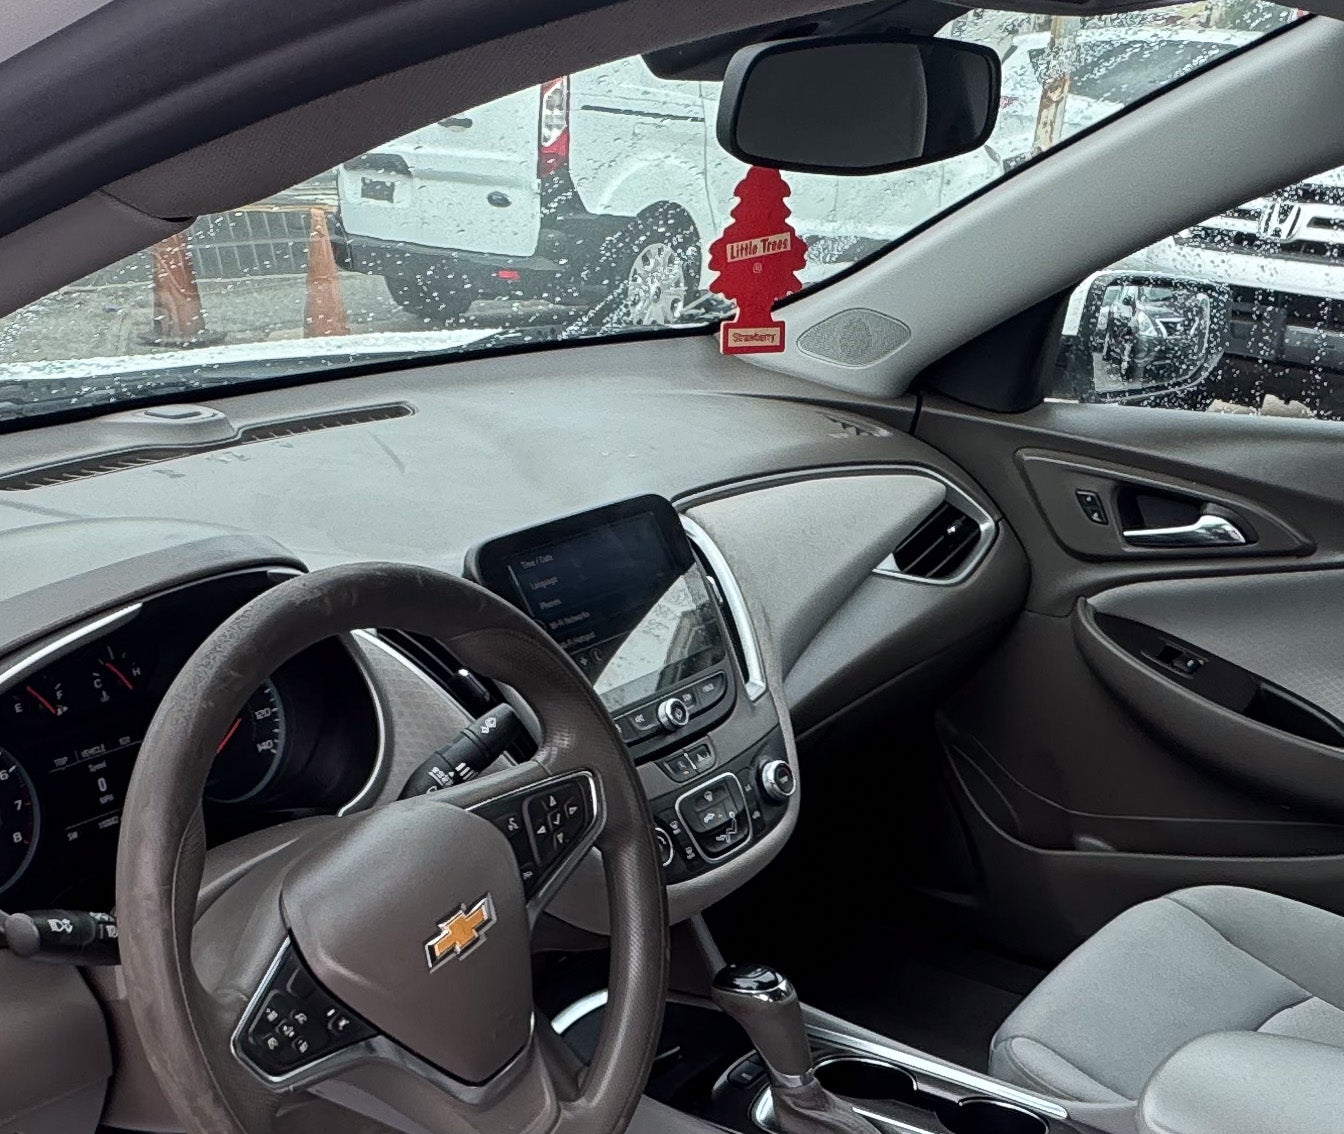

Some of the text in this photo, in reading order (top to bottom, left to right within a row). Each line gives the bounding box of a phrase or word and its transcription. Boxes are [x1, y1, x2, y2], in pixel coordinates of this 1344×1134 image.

[730, 238, 788, 260] Little Trees
[732, 331, 776, 343] Strawberry
[93, 667, 141, 688] C H
[14, 702, 24, 713] E
[255, 707, 272, 719] 120
[97, 777, 108, 792] 0
[14, 799, 23, 811] 7
[12, 832, 23, 844] 8
